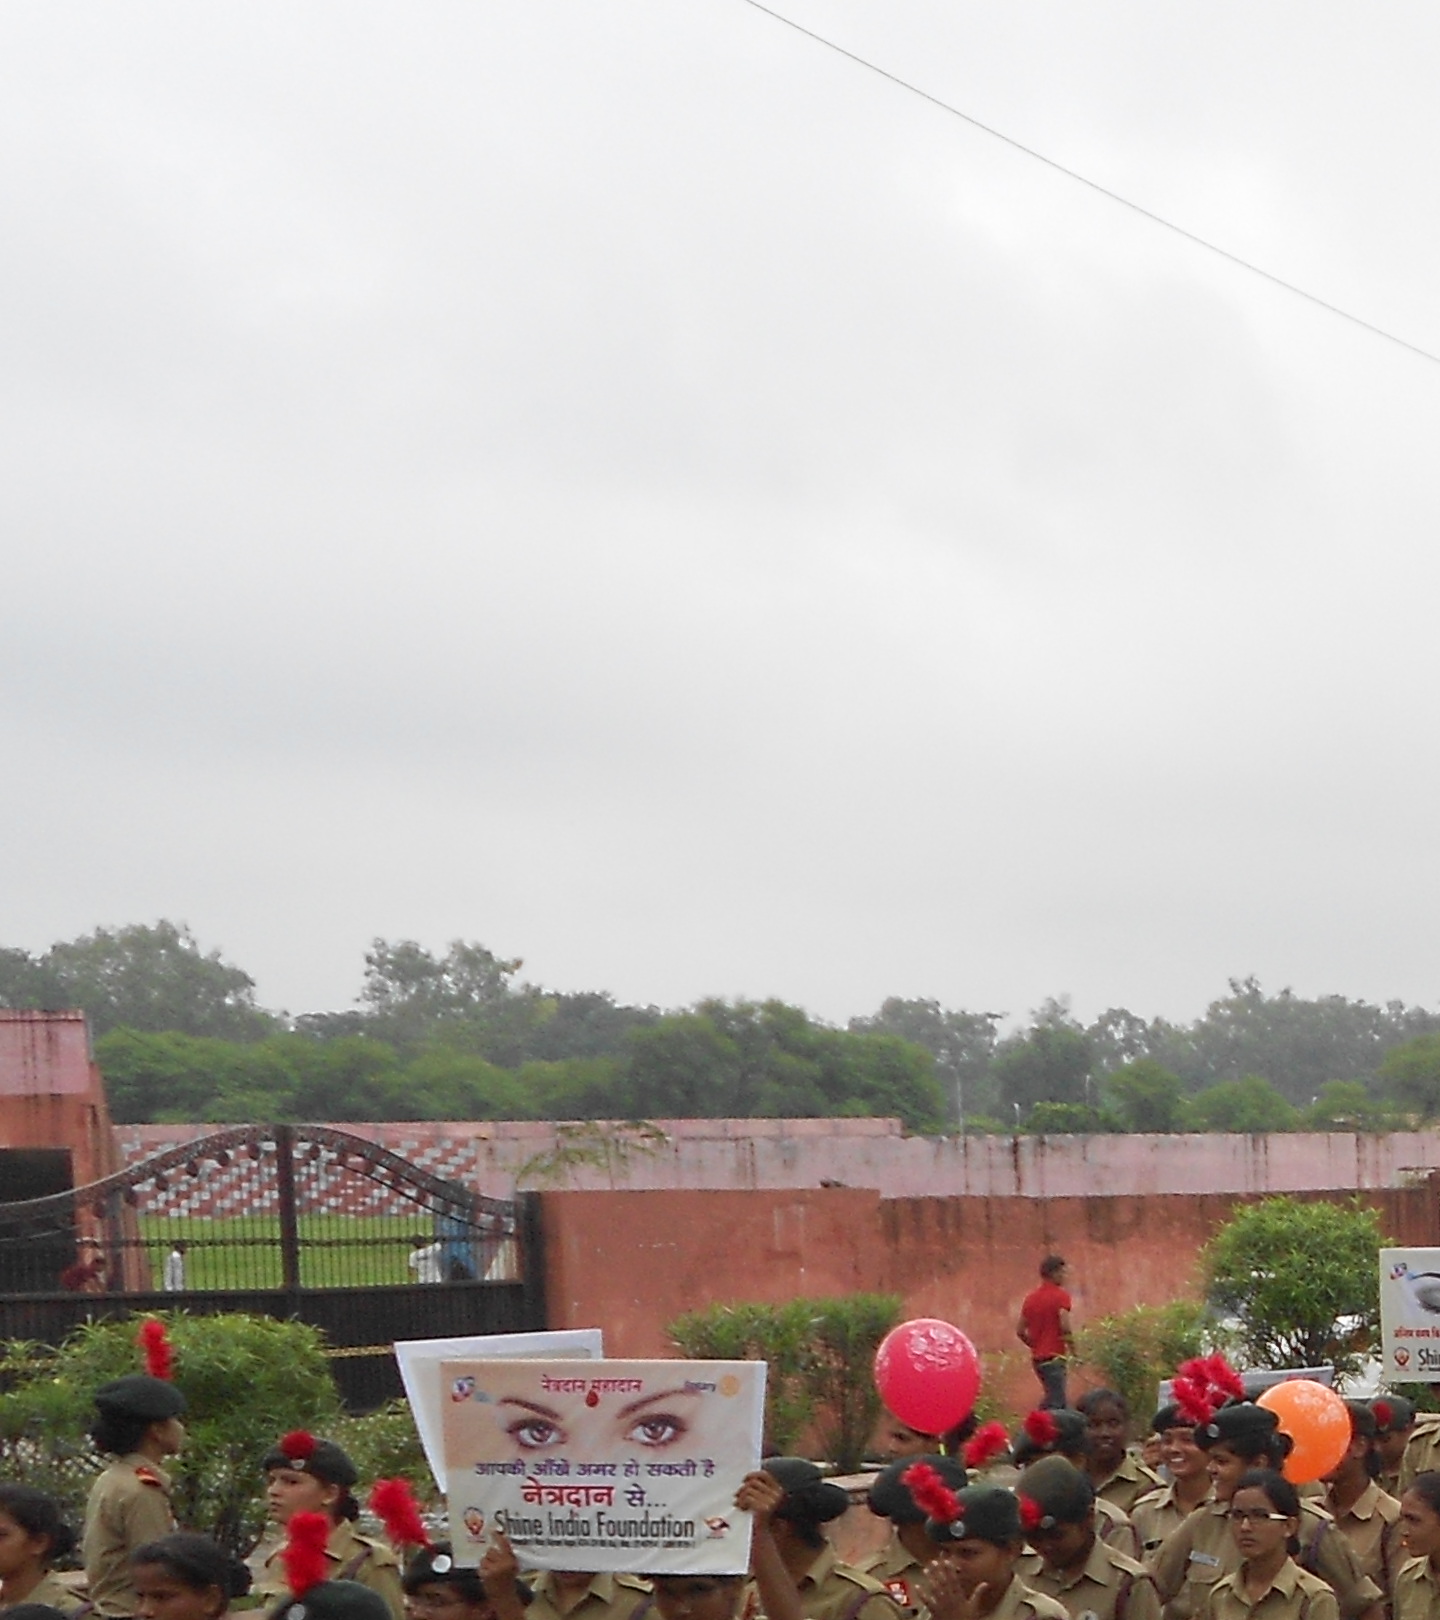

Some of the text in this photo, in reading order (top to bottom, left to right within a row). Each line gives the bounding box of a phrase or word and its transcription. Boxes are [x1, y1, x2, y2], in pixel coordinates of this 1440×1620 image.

[541, 1373, 643, 1392] नेत्रदान महादान
[475, 1458, 527, 1476] आपकी
[577, 1463, 618, 1476] अमर
[622, 1458, 641, 1477] हो
[645, 1458, 699, 1477] सकती
[700, 1458, 716, 1478] है
[520, 1476, 615, 1508] नेत्रदान
[494, 1509, 696, 1538] Shine India Foundation
